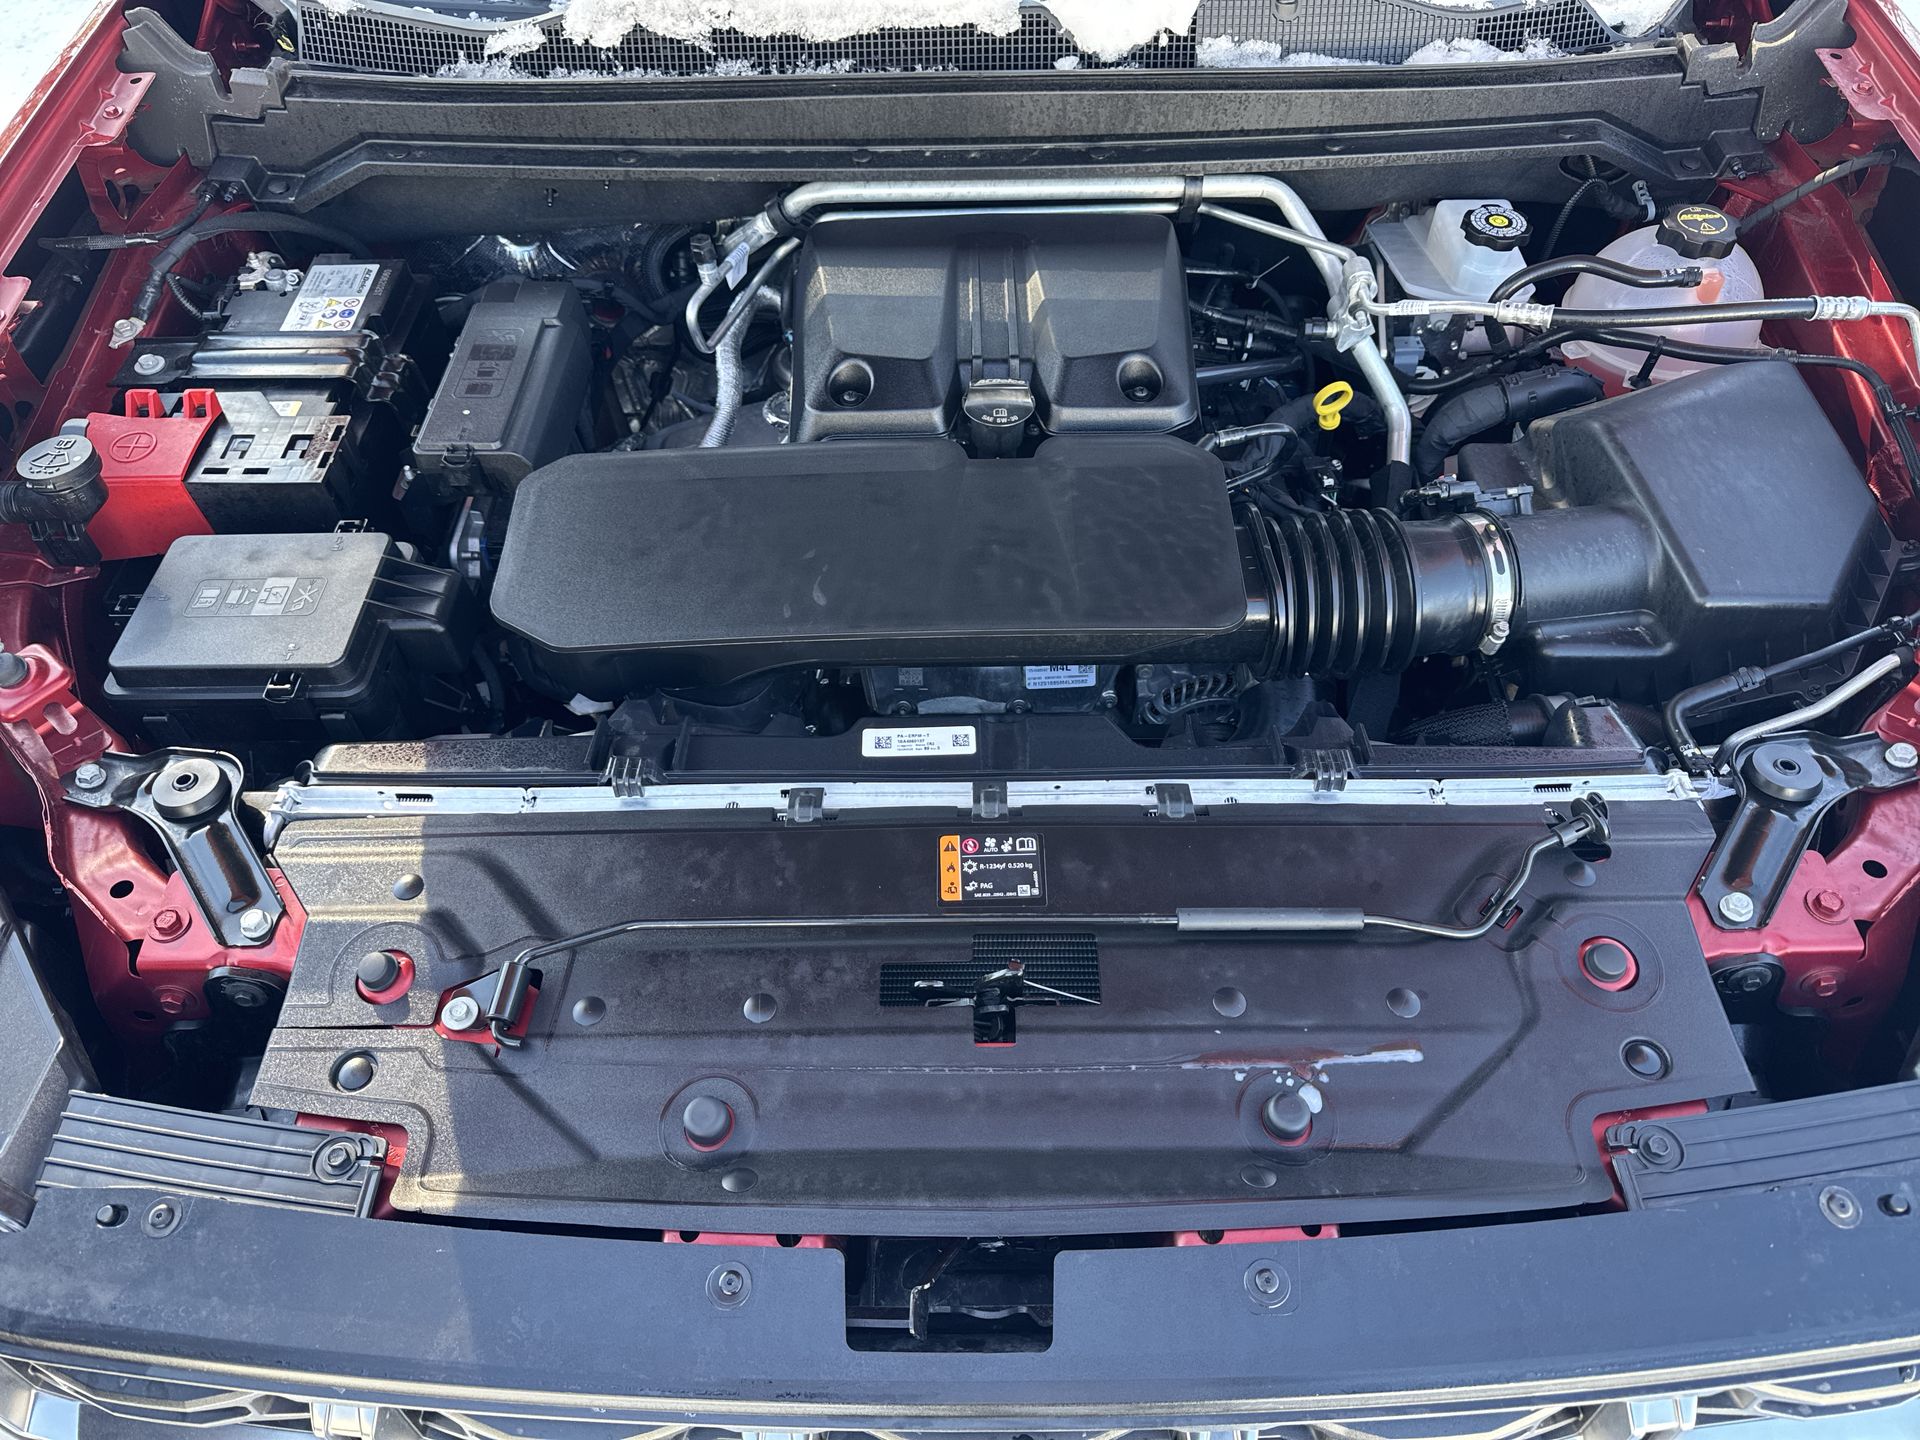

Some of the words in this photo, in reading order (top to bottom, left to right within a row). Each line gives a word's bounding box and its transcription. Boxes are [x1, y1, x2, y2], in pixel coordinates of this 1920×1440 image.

[357, 268, 373, 294] ACDelco
[974, 378, 1026, 387] ACDelco
[981, 415, 995, 423] SAE
[979, 862, 1006, 870] R-1234yf
[1024, 861, 1033, 870] kg
